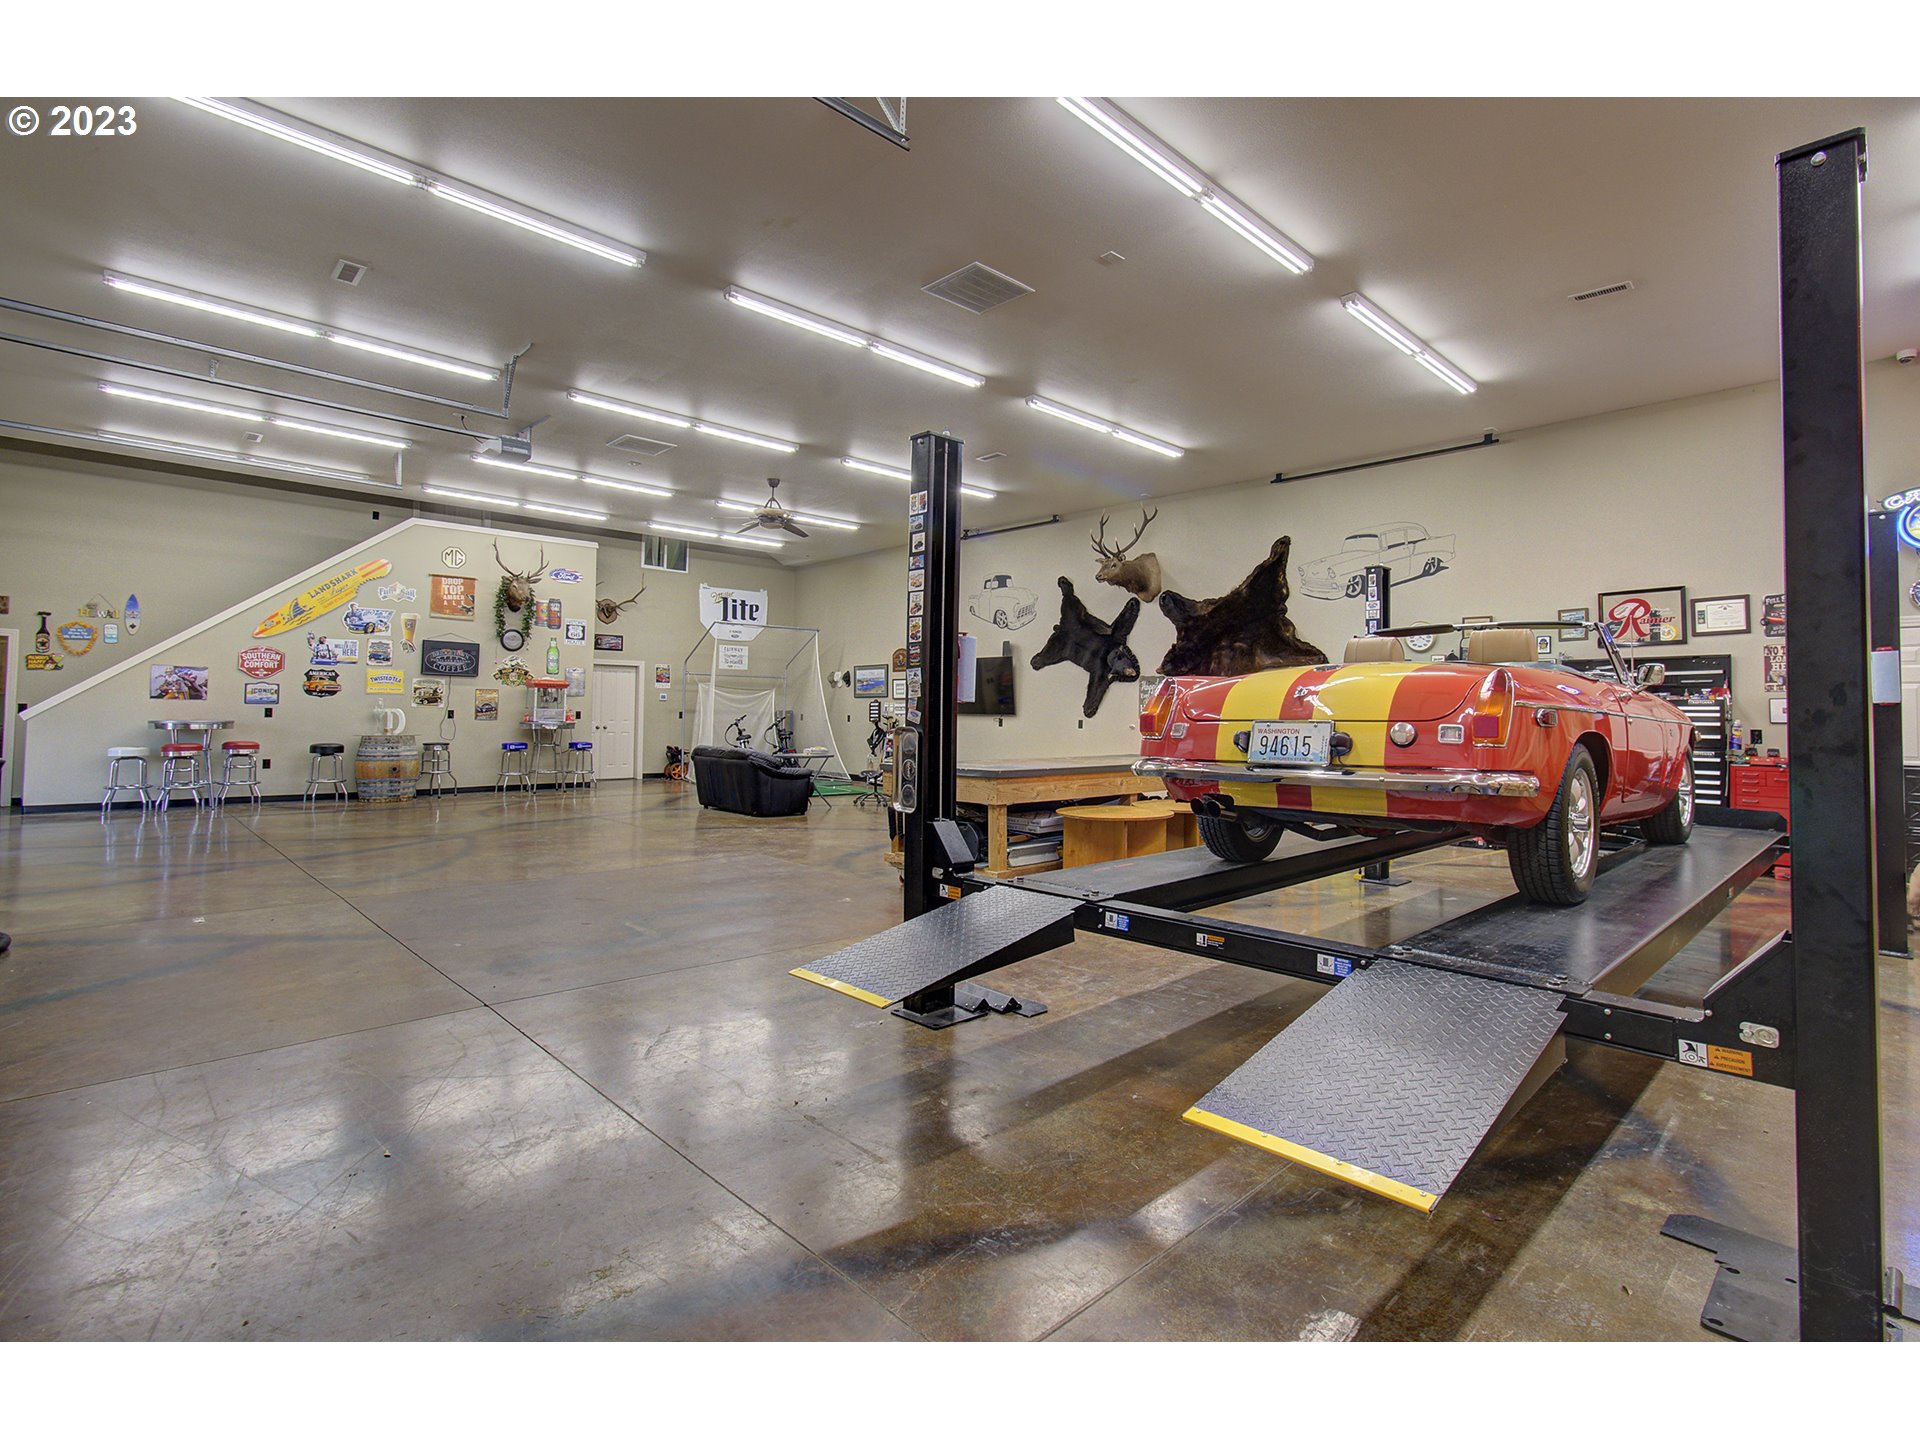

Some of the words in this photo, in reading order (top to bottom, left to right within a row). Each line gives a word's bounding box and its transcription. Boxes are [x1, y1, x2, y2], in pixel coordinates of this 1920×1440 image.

[307, 568, 359, 598] LANDSHARK
[442, 577, 464, 585] DROP
[443, 585, 464, 594] TOP
[241, 652, 282, 661] SOUTHERN
[342, 648, 358, 657] HERE
[244, 660, 279, 669] COMFORT
[433, 662, 468, 672] COFFEE
[370, 674, 392, 682] TWISTED
[1259, 735, 1312, 757] 94615
